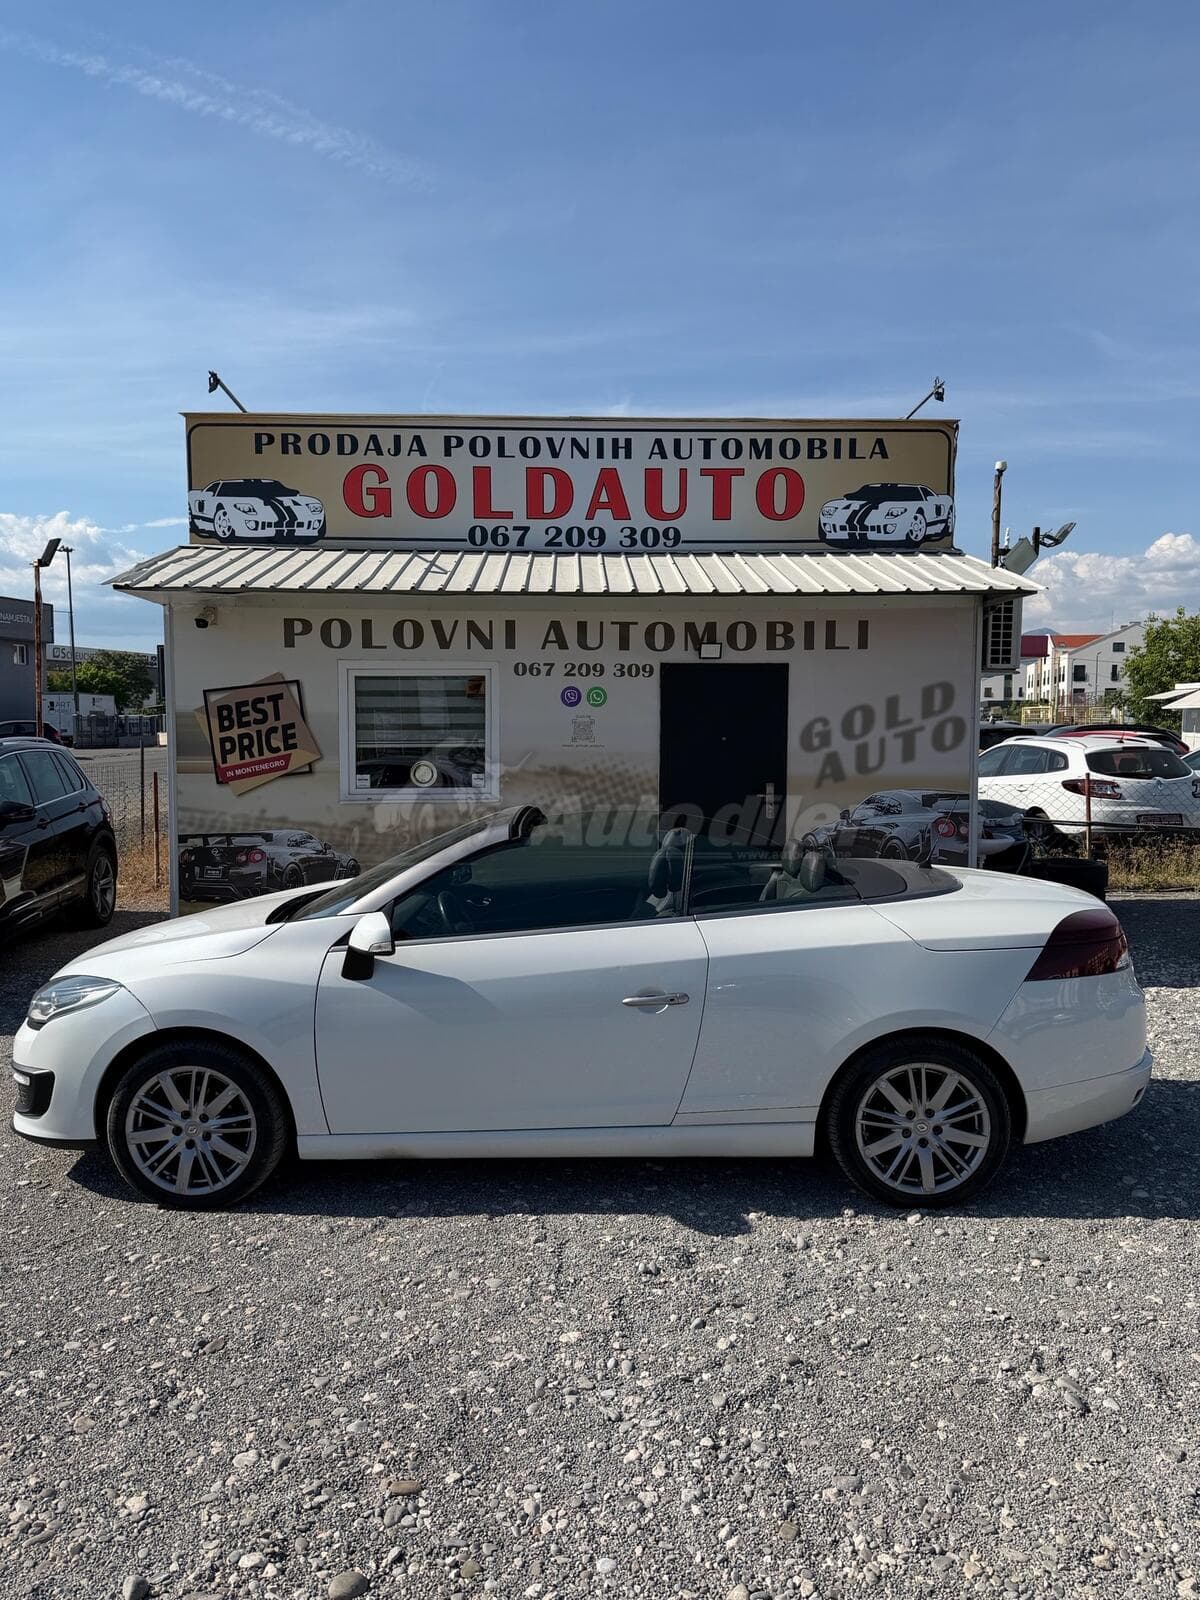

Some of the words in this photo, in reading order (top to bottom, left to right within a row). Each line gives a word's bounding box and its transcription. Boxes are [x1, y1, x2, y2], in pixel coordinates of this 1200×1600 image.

[254, 432, 428, 457] PRODAJA
[443, 435, 633, 460] POLOVNIH
[648, 437, 890, 460] AUTOMOBILA
[343, 463, 806, 521] GOLDAUTO
[467, 525, 531, 547] 067
[544, 526, 606, 548] 209
[619, 526, 682, 548] 309
[283, 617, 516, 650] POLOVNI
[541, 620, 870, 651] AUTOMOBILI
[513, 662, 554, 677] 067
[564, 662, 606, 678] 209
[613, 663, 655, 679] 309
[216, 693, 285, 734] BEST
[799, 680, 956, 753] GOLD
[219, 722, 299, 765] PRICE
[814, 715, 967, 790] AUTO
[226, 769, 235, 778] IN
[235, 759, 286, 776] MONTENEGRO
